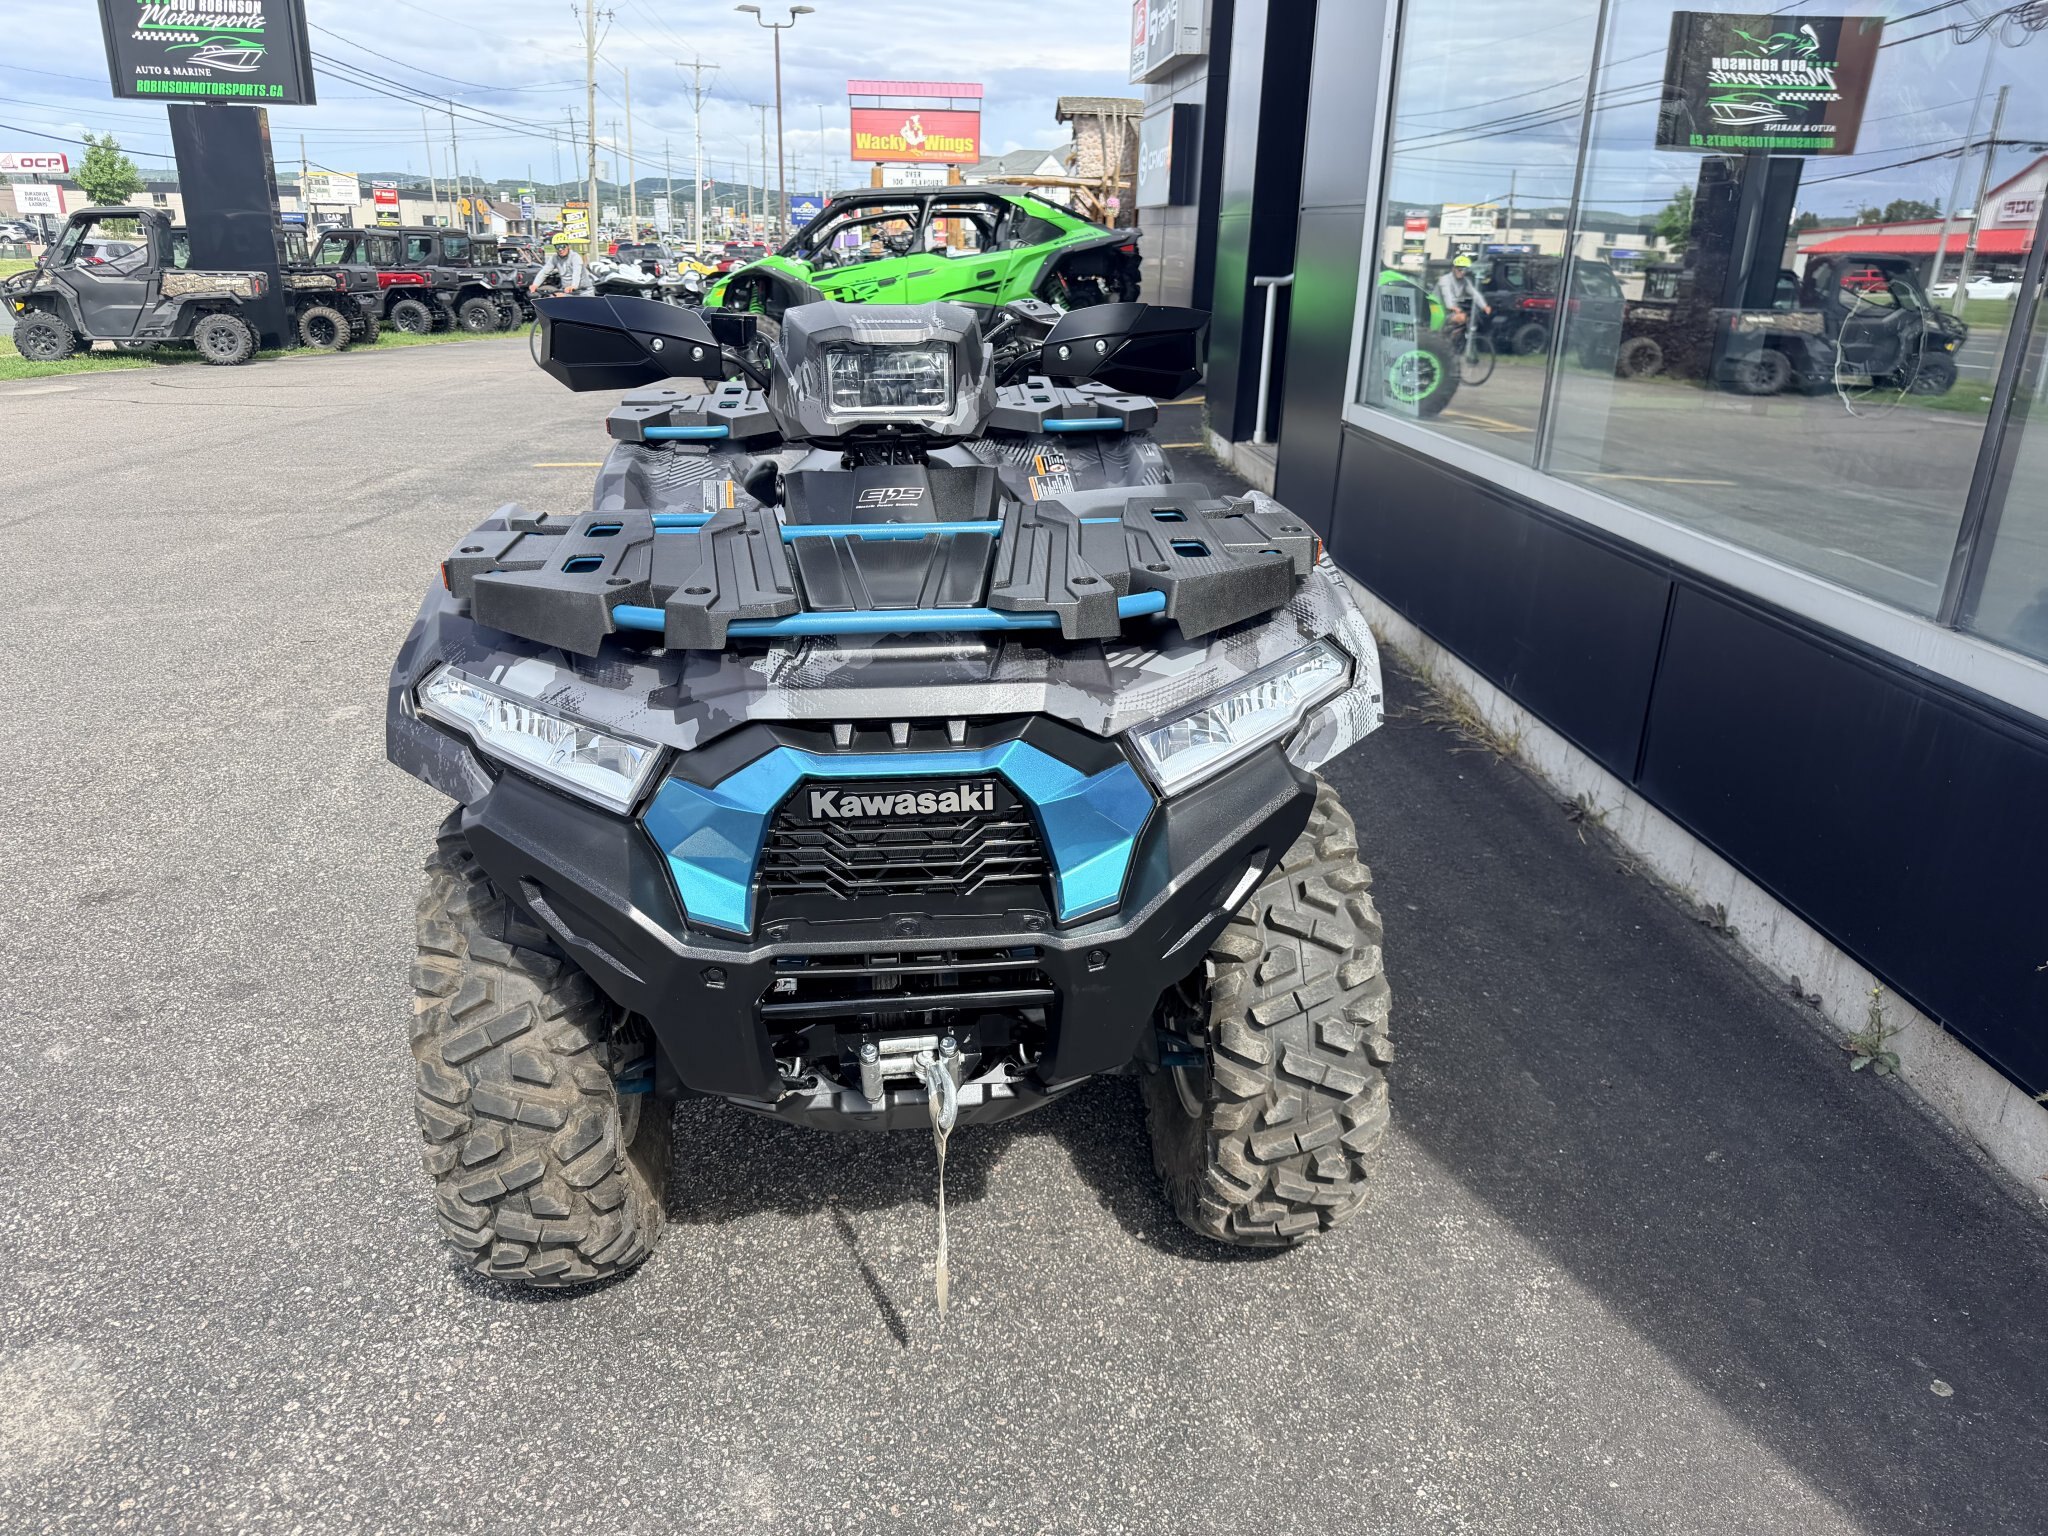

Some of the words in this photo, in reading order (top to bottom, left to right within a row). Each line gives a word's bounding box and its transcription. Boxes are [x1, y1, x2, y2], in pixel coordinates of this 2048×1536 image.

[199, 0, 262, 14] ROBINSON
[137, 3, 267, 31] Motorsports
[135, 66, 162, 75] AUTO
[163, 67, 171, 75] &
[173, 67, 212, 77] MARINE
[136, 79, 284, 98] ROBINSONMOTORSPORTS.CA
[855, 132, 908, 152] Wacky
[924, 134, 975, 153] Wings
[20, 158, 61, 168] OCP
[904, 170, 921, 178] OVER
[859, 487, 925, 504] EPS
[810, 783, 994, 819] Kawasaki
